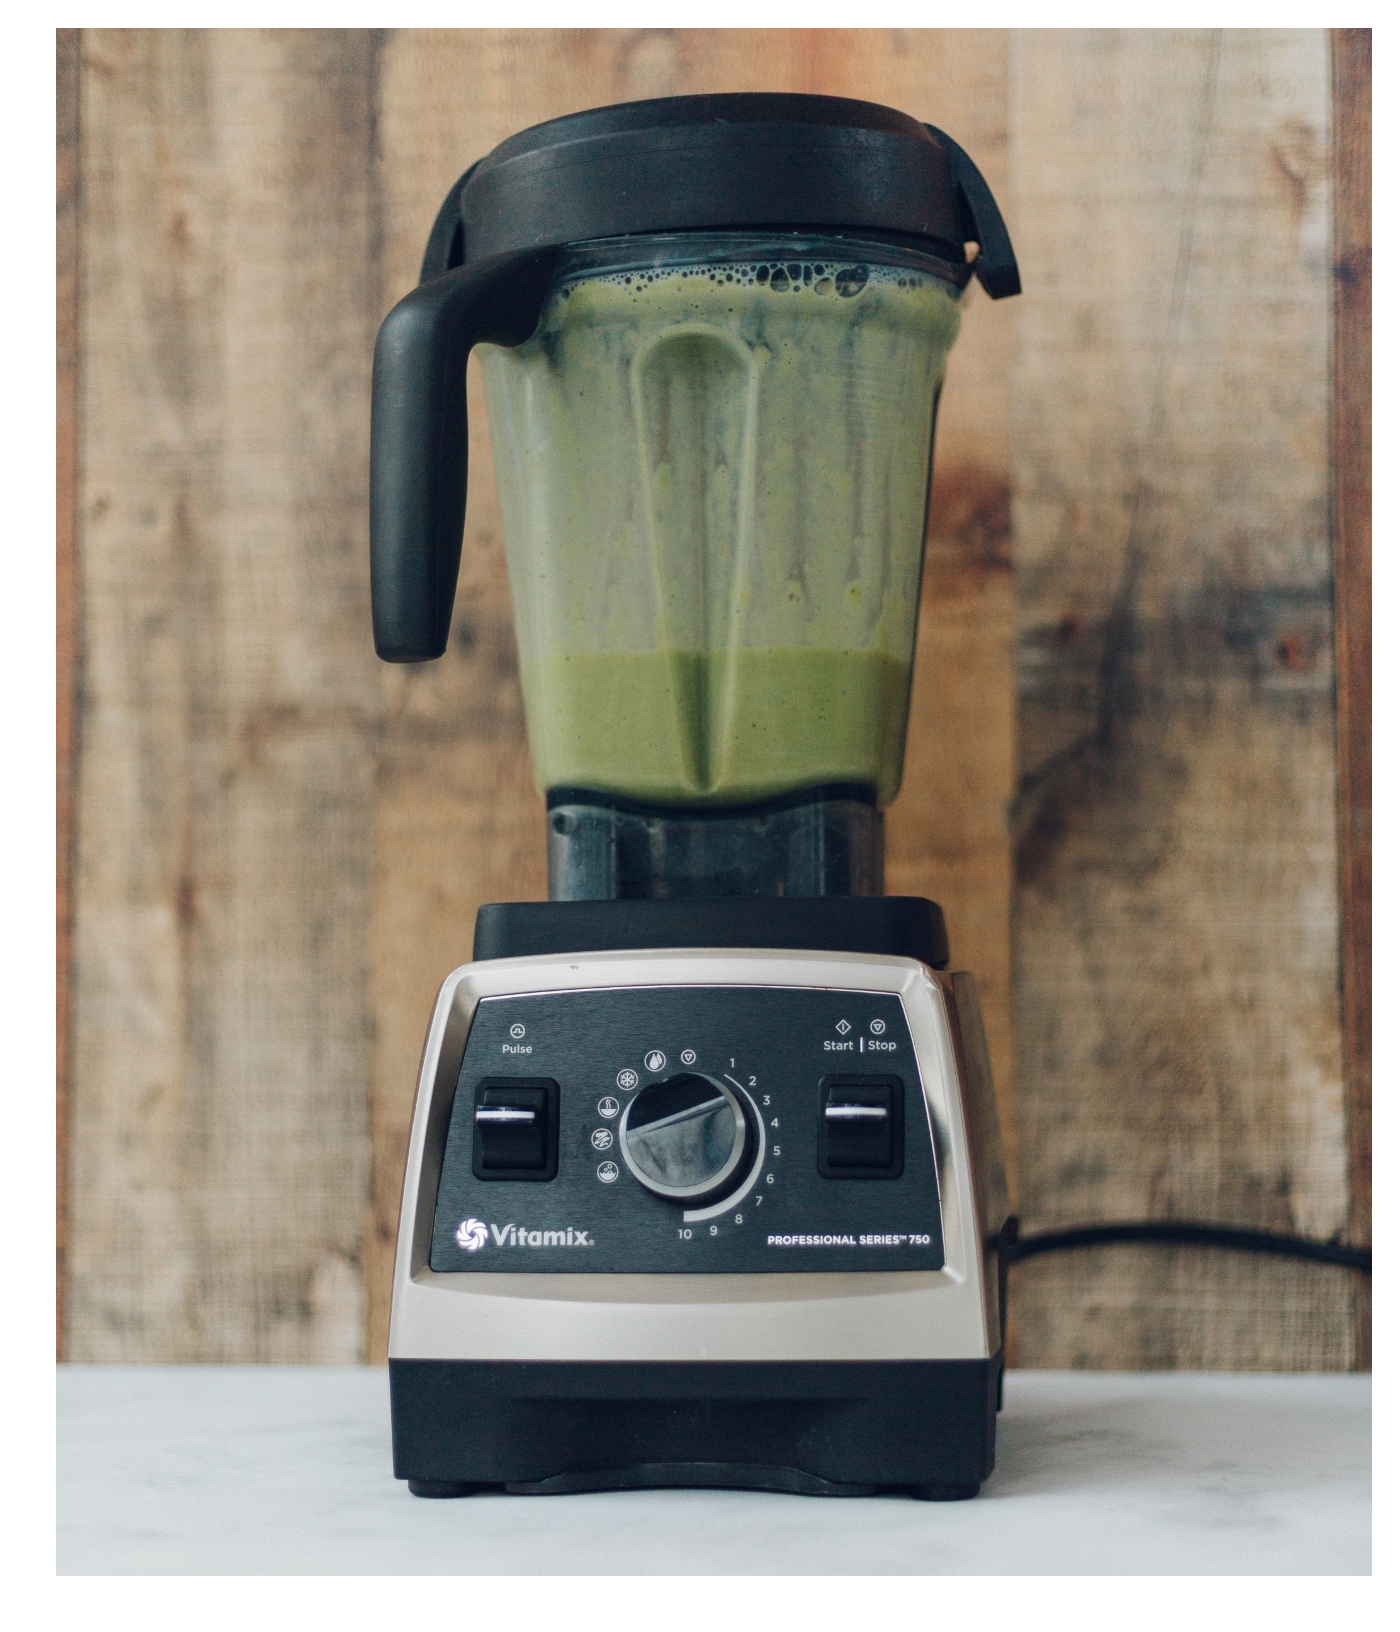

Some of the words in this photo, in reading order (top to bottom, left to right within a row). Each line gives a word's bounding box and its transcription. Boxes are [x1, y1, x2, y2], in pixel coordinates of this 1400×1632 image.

[502, 1043, 533, 1054] Pulse
[823, 1040, 854, 1051] Start
[867, 1040, 897, 1052] Stop
[748, 1075, 757, 1086] 2
[762, 1094, 771, 1106] 3
[770, 1117, 780, 1128] 4
[772, 1145, 781, 1156] 5
[766, 1173, 775, 1184] 6
[755, 1195, 763, 1206] 7
[734, 1213, 743, 1225] 8
[677, 1228, 693, 1240] 10
[709, 1225, 718, 1236] 9
[767, 1234, 857, 1246] PROFESSIONAL
[908, 1234, 931, 1245] 750
